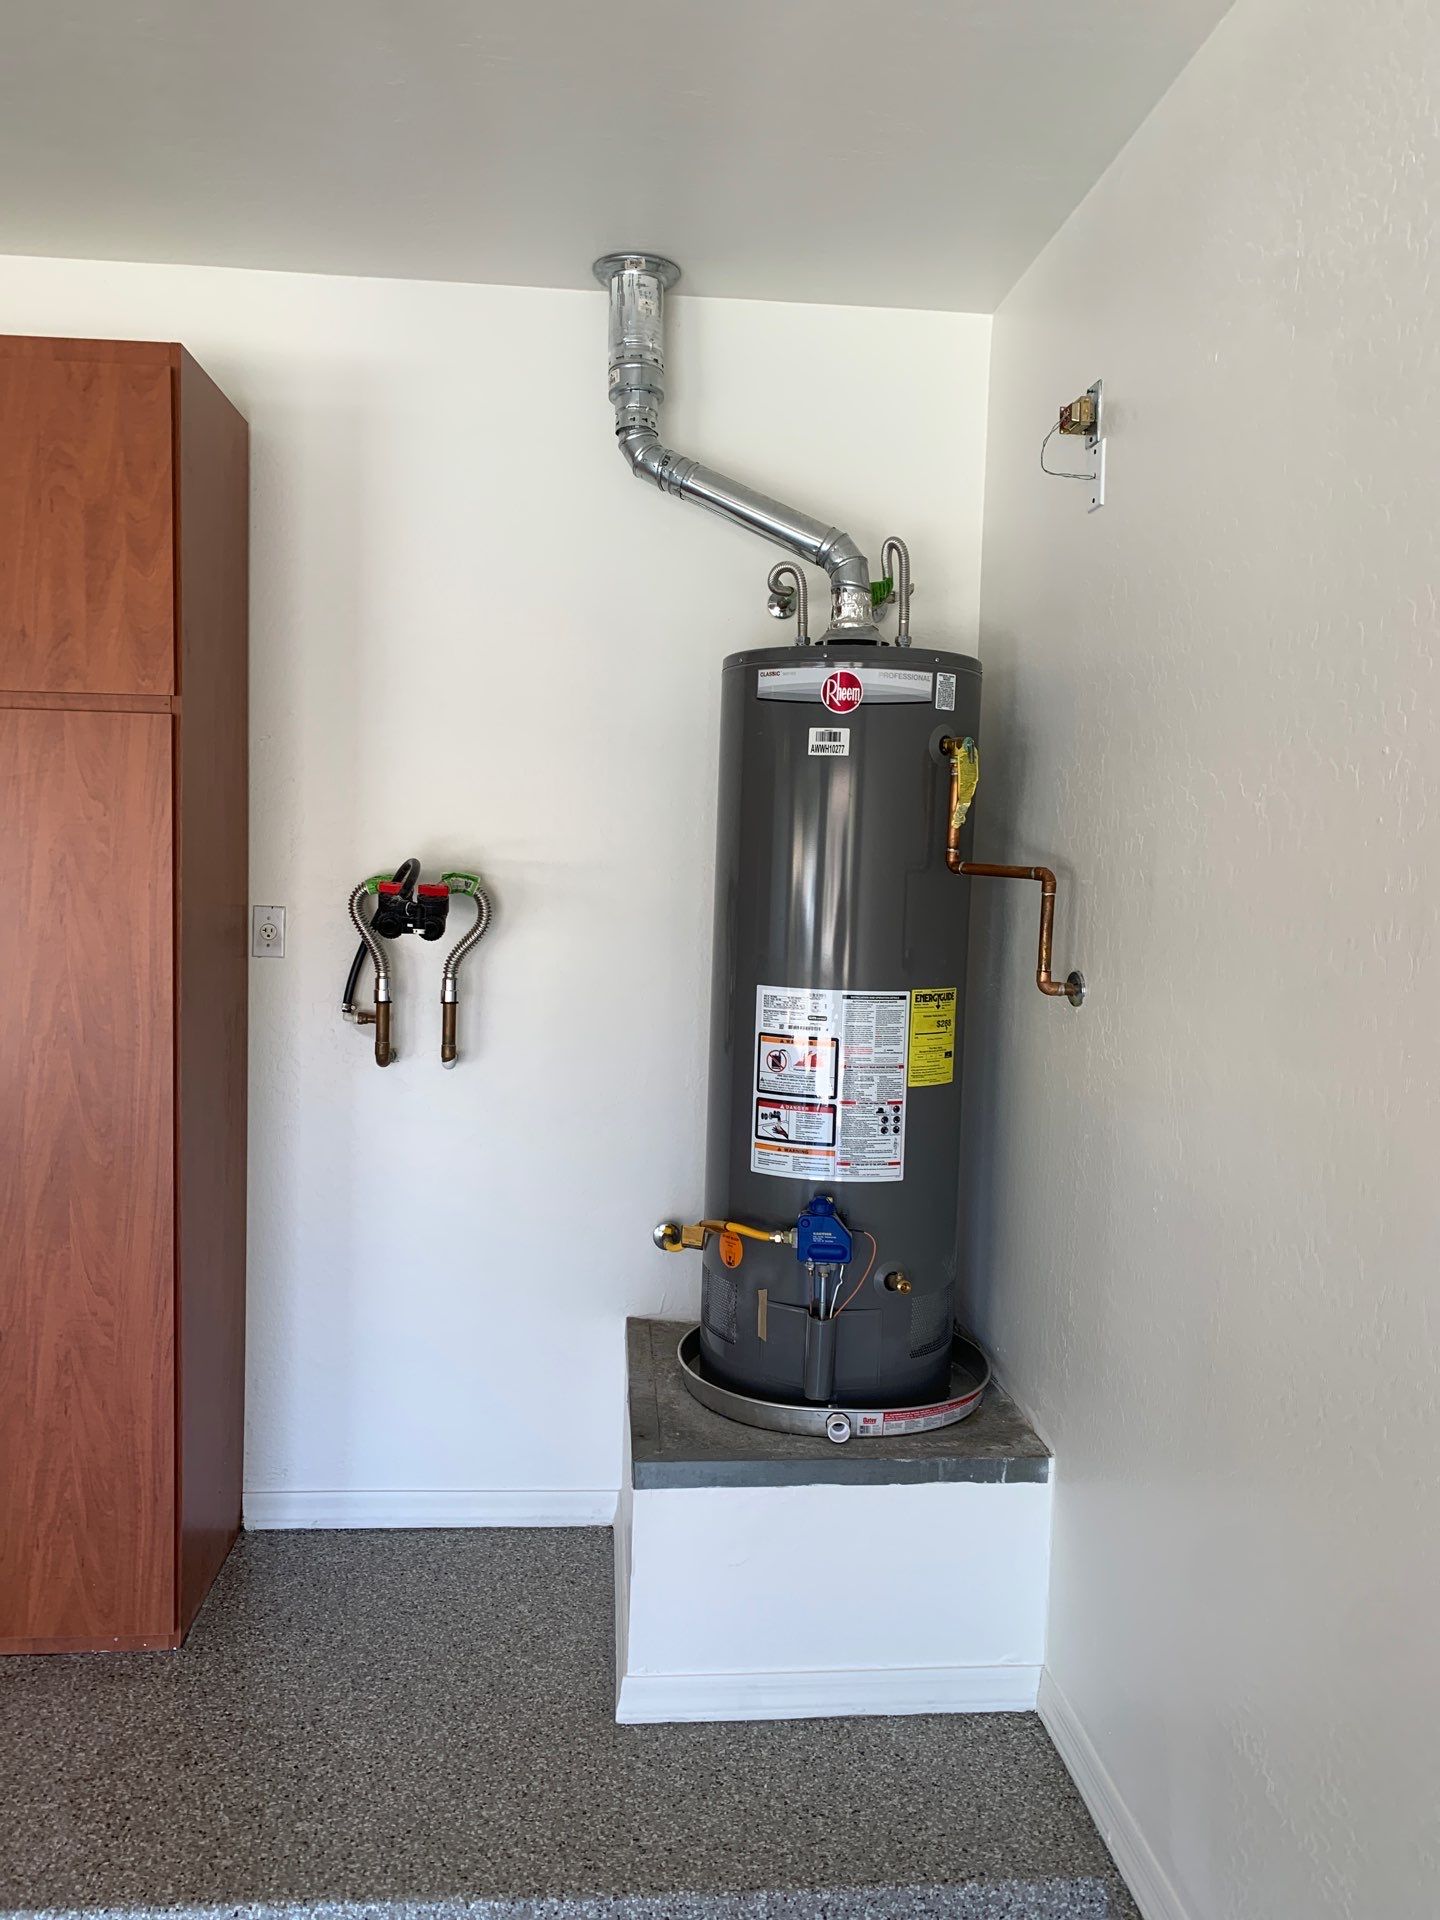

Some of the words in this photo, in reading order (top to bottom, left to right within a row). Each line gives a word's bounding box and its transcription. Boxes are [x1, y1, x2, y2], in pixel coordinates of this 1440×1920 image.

[879, 672, 931, 681] PROFESSIONAL
[826, 671, 860, 706] Rheem
[811, 744, 845, 753] AWWH10277
